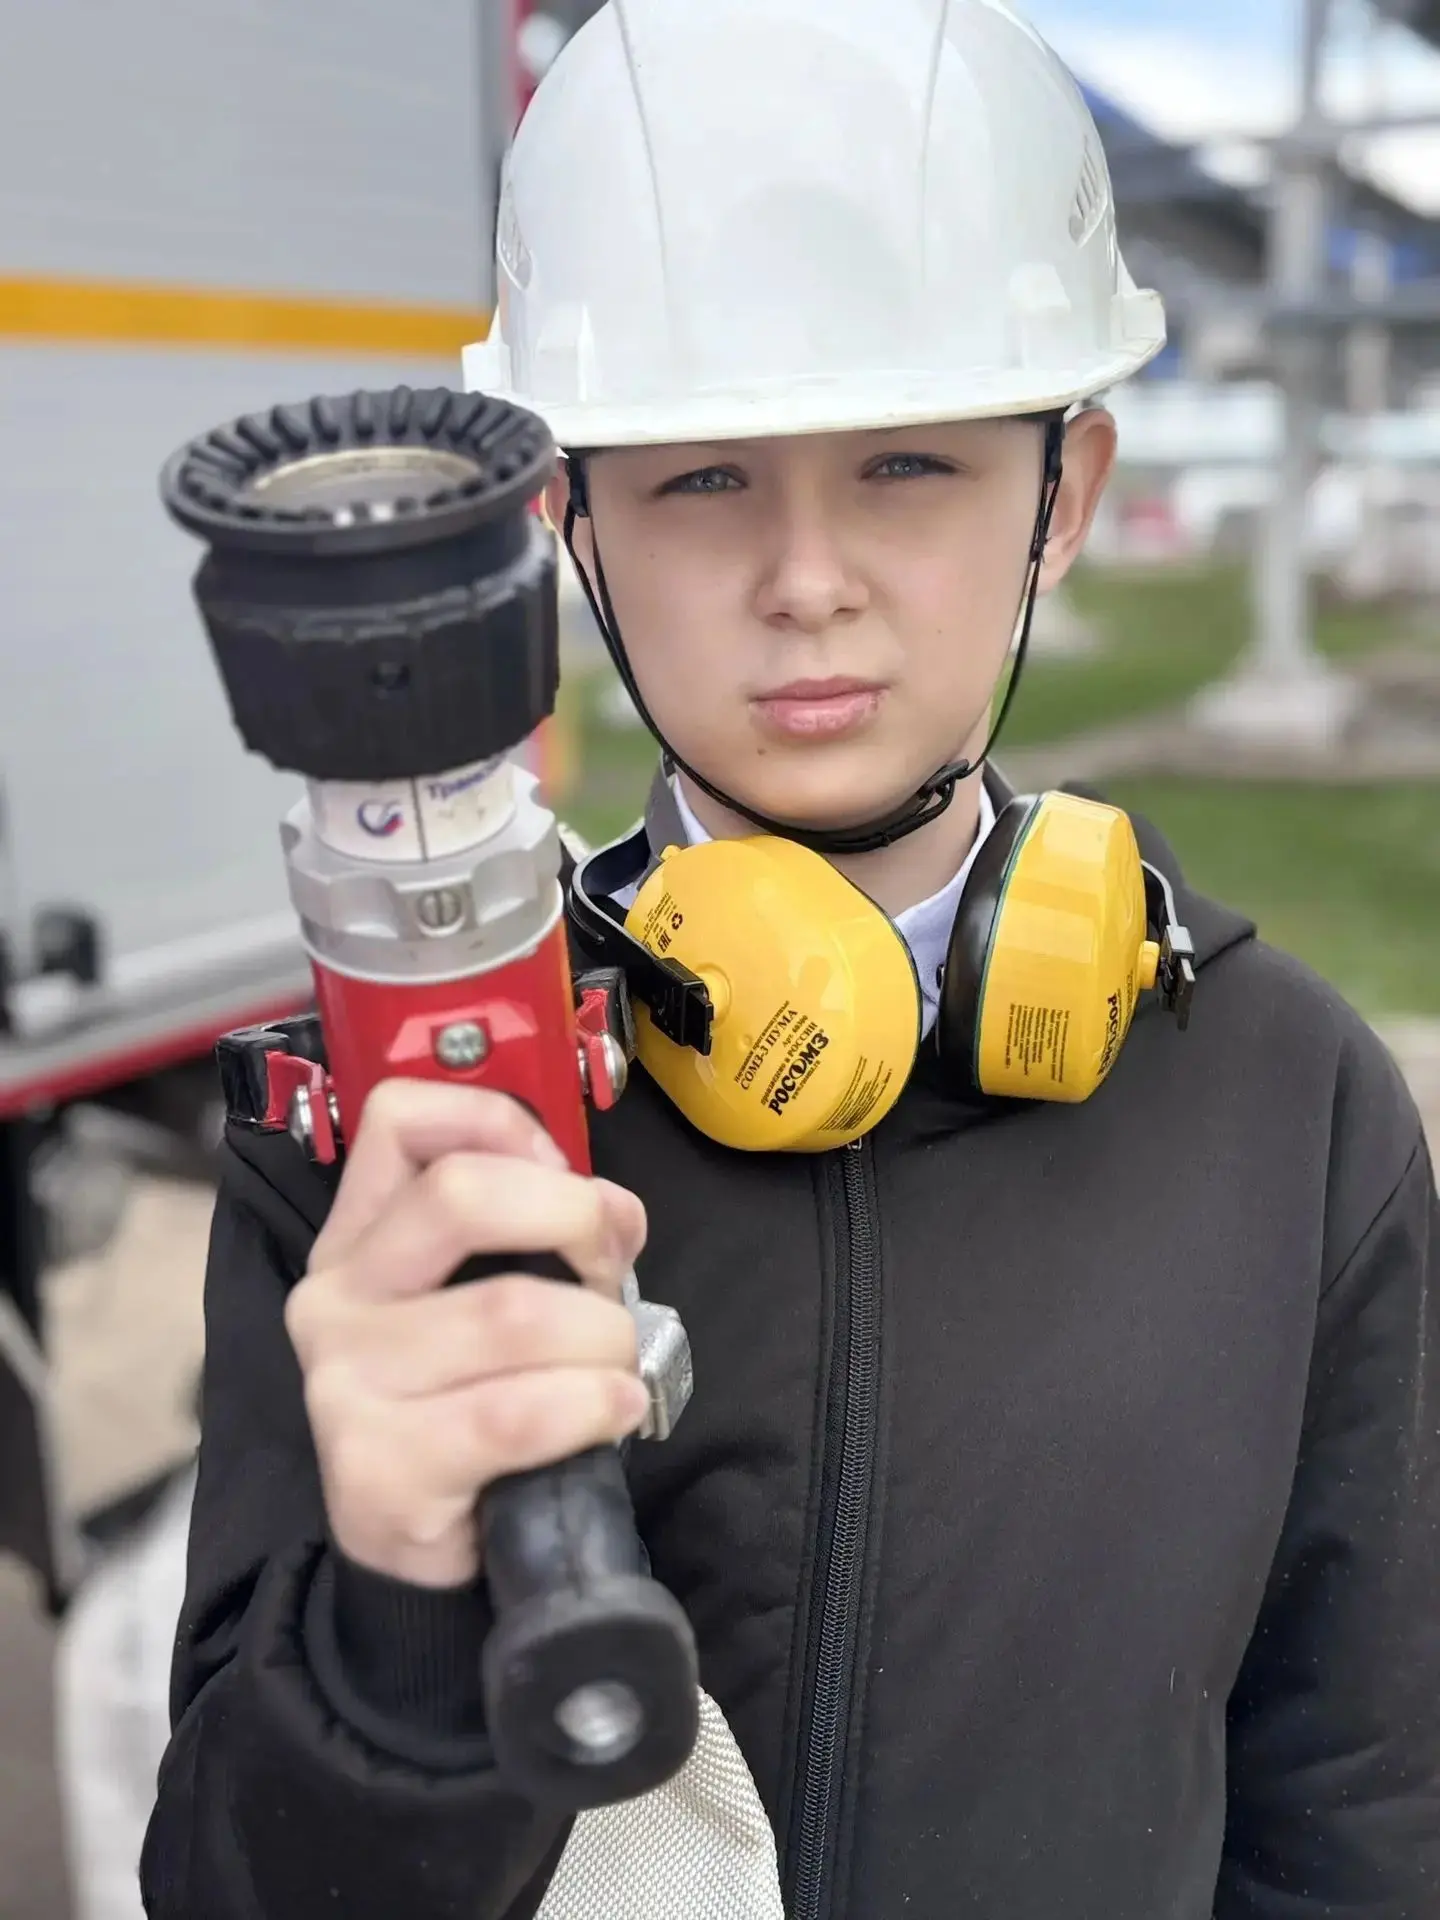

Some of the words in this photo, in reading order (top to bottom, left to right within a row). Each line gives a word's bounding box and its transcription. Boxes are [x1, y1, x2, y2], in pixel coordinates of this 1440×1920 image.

[740, 1045, 769, 1091] СОМЗ-3
[765, 1009, 798, 1047] ПУМА
[768, 1032, 830, 1116] РОСОМЗ
[787, 1021, 818, 1058] РОССИИ
